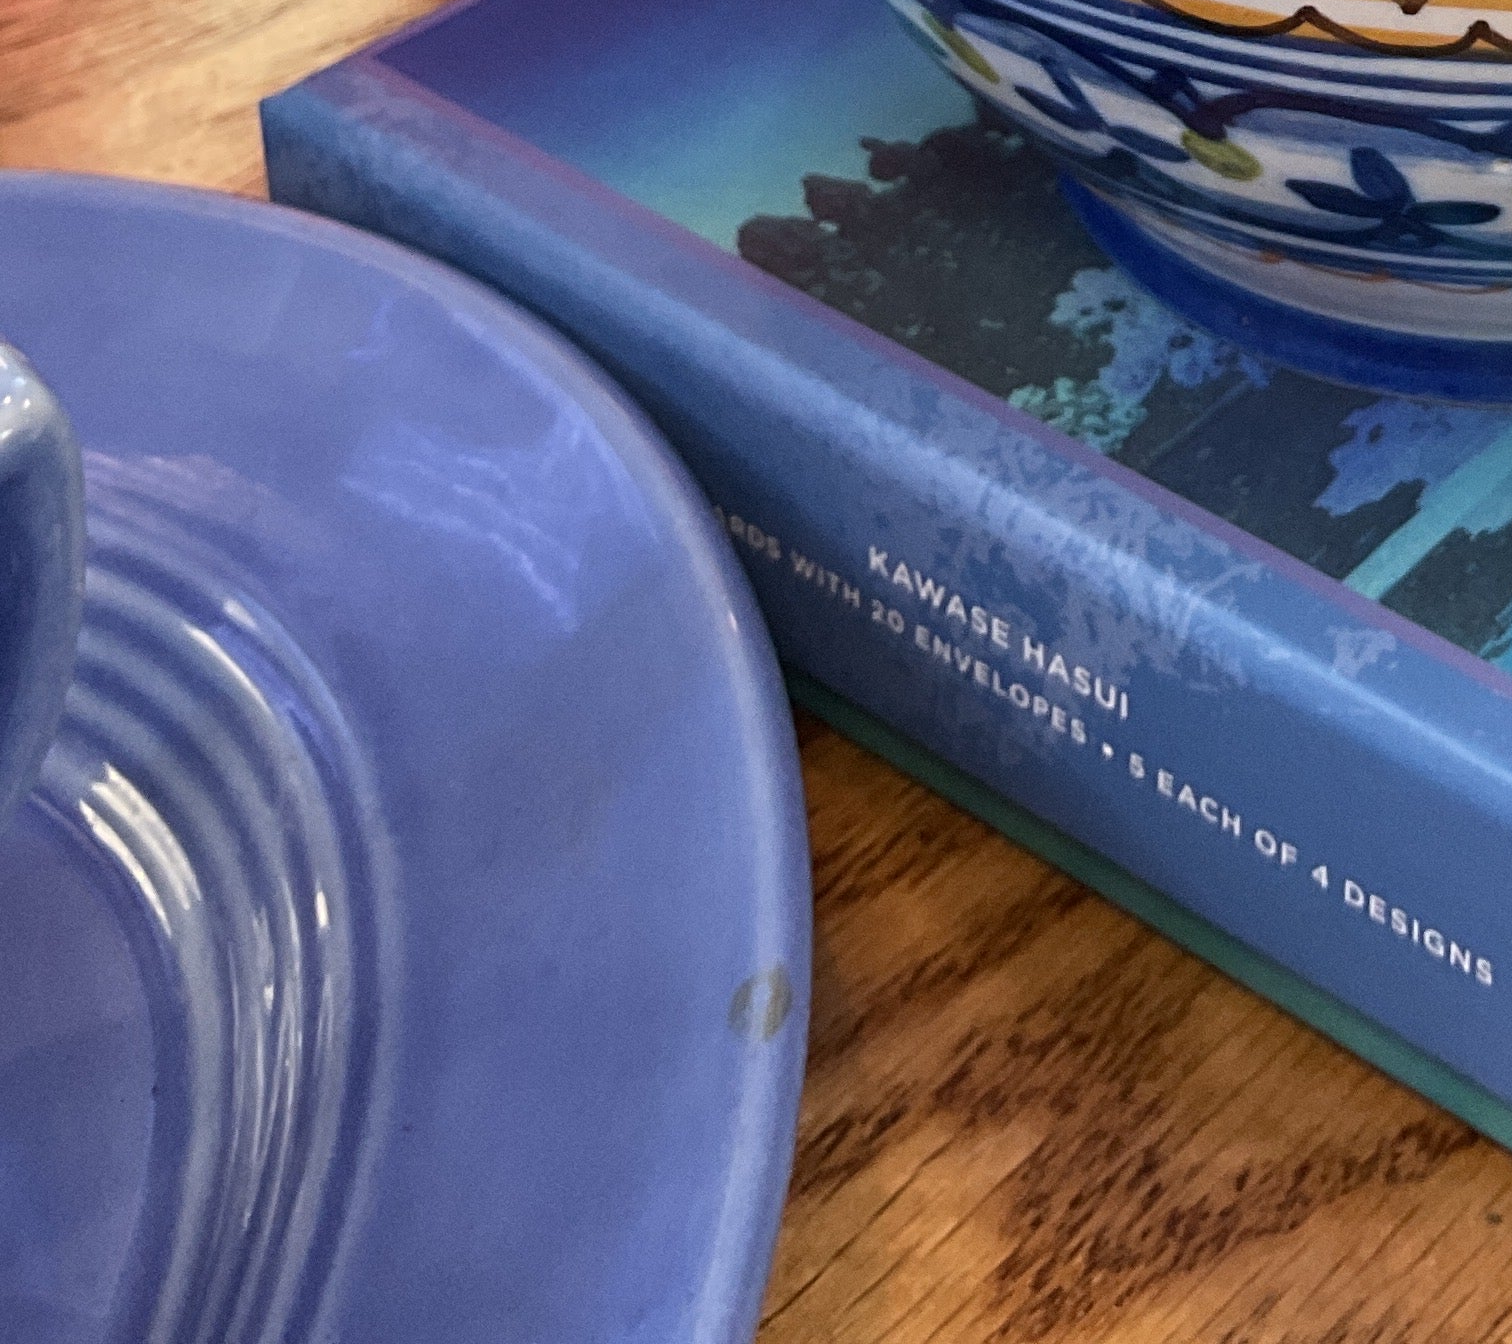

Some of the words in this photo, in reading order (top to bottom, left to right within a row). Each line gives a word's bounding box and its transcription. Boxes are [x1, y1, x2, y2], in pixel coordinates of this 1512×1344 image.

[790, 548, 860, 609] WITH
[871, 599, 905, 634] 20
[914, 624, 1086, 744] ENVELOPES
[1129, 752, 1145, 779] 5
[1157, 768, 1241, 837] EACH
[1254, 828, 1298, 866] OF
[1311, 865, 1329, 890] 4
[1344, 878, 1493, 986] DESIGNS
[868, 545, 1011, 650] KAWASE
[1023, 635, 1128, 720] HASUI
